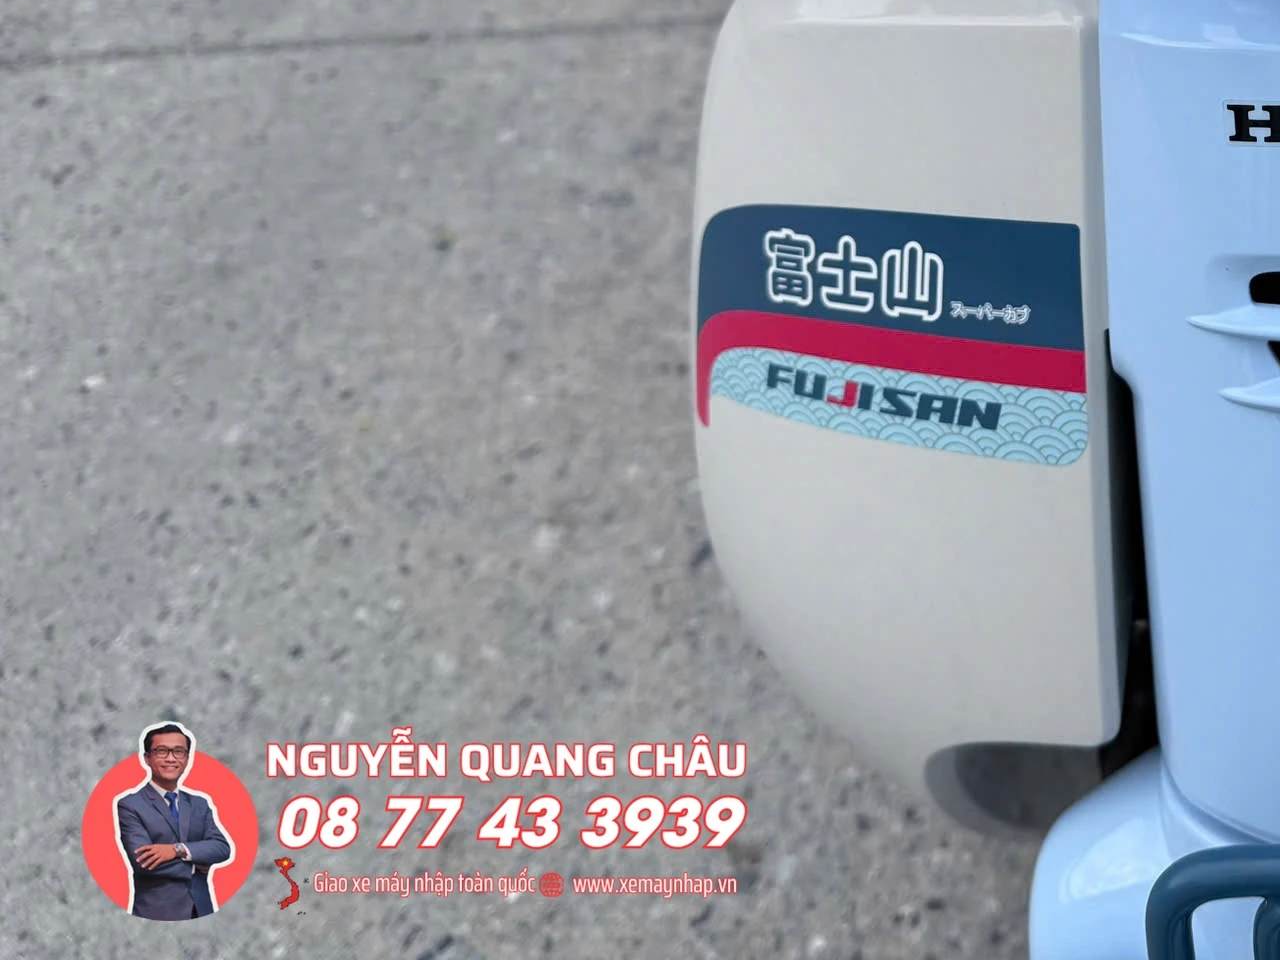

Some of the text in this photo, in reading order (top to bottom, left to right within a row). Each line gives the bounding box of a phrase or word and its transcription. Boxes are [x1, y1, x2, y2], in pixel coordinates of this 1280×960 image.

[764, 227, 1032, 325] 富士山 スーパーカブ
[766, 363, 1003, 430] FUJISAN
